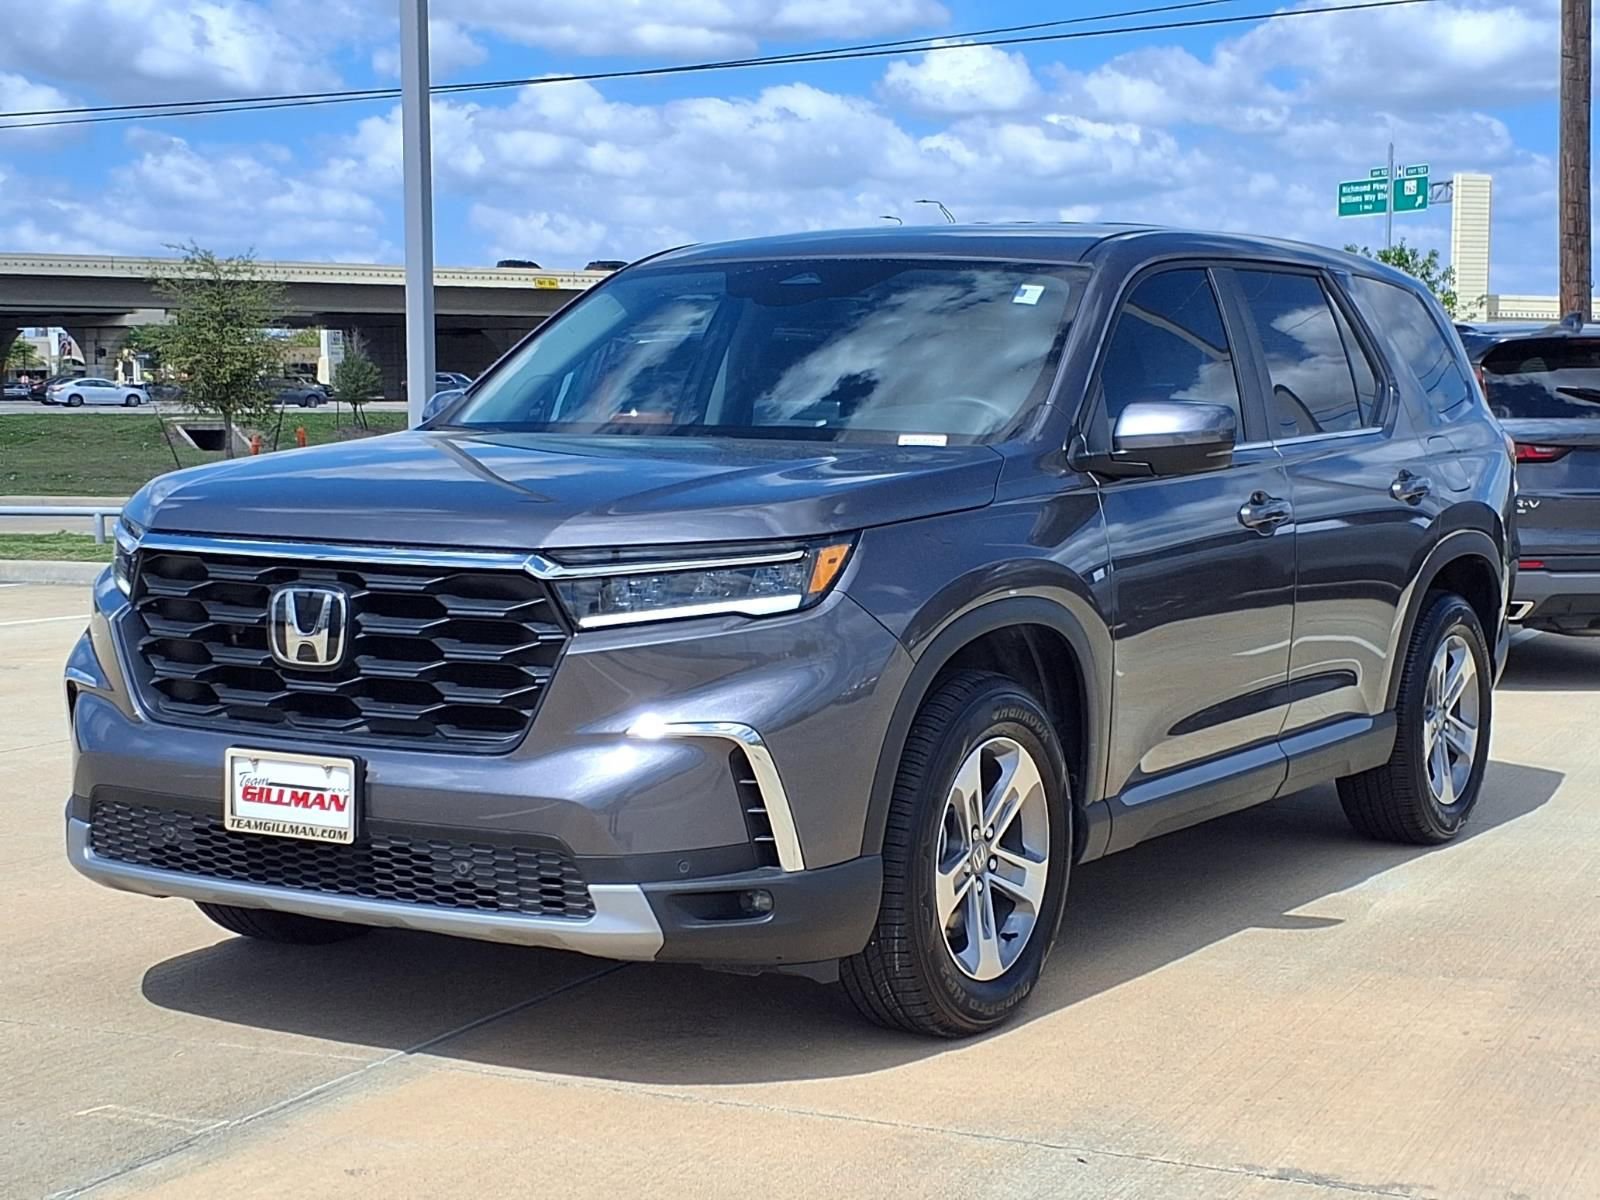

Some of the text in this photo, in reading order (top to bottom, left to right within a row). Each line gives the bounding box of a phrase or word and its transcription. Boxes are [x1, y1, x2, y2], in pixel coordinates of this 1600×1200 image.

[1342, 183, 1371, 194] Richmond
[239, 771, 270, 787] Team
[241, 784, 350, 813] GILLMAN
[229, 817, 349, 841] TEAMGILLMAN.COM
